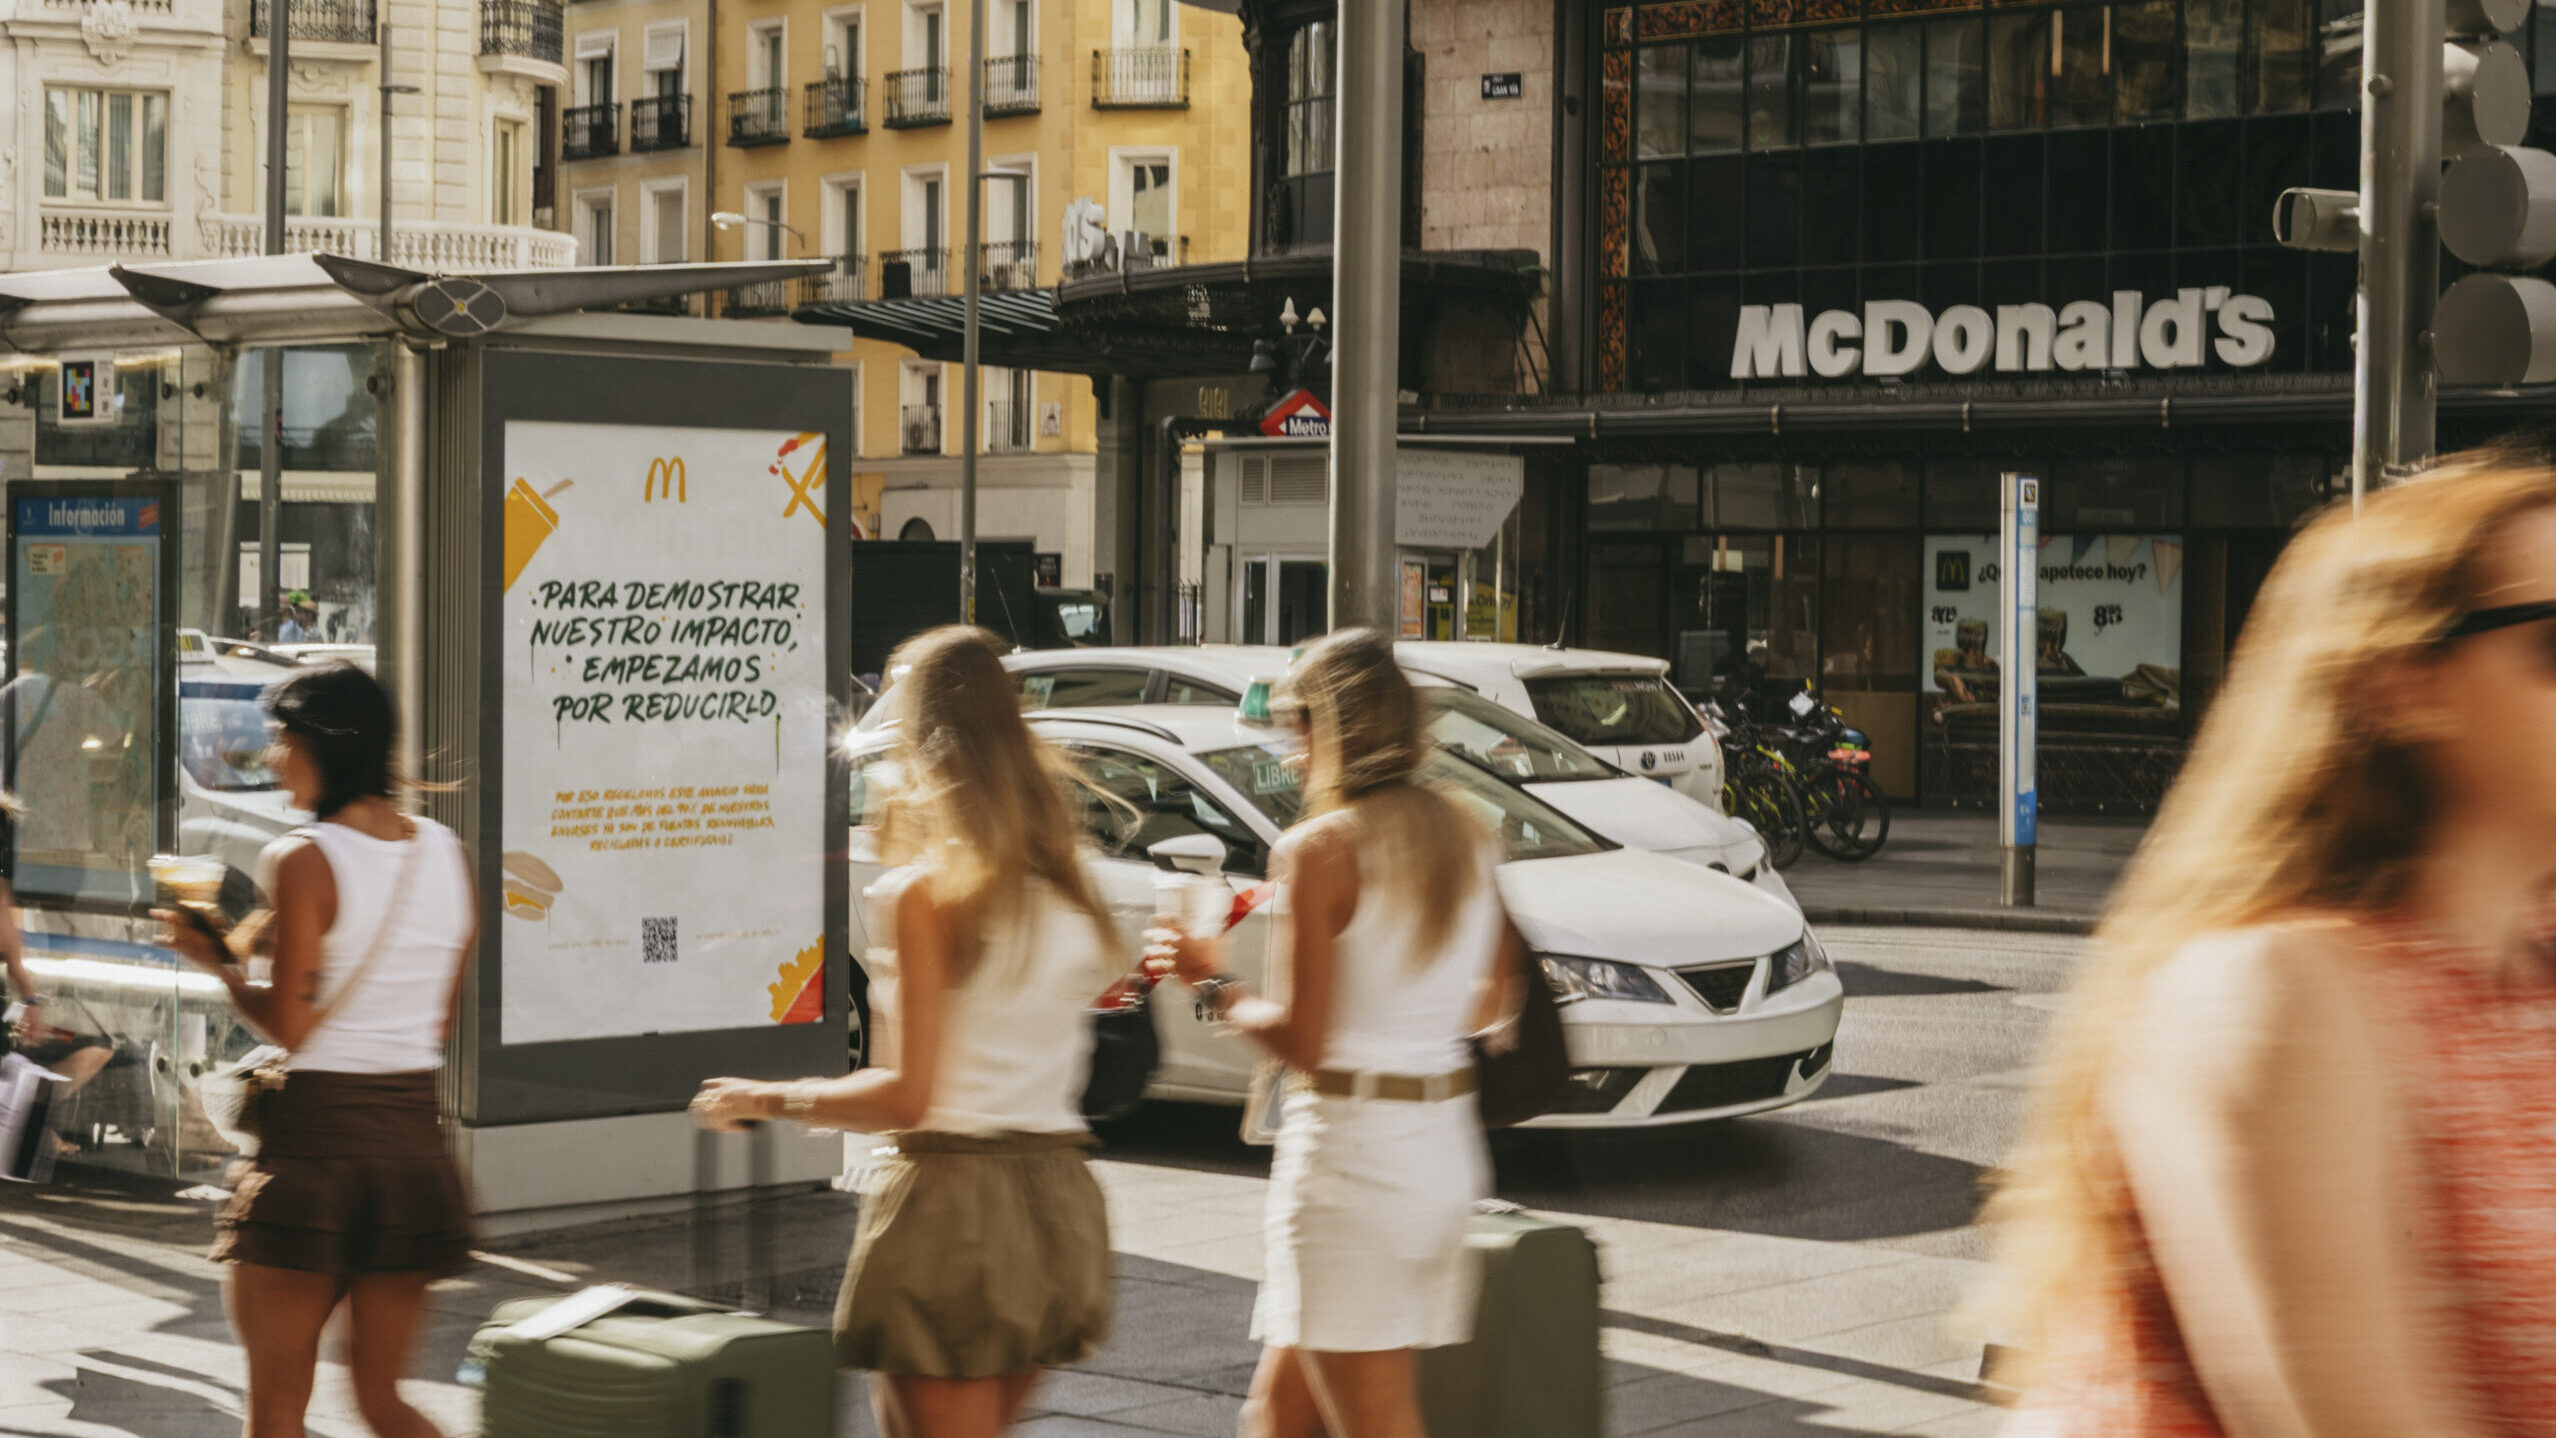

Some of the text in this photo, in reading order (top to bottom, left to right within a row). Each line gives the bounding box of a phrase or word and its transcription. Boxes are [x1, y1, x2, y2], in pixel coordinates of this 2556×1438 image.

[1730, 286, 2275, 379] McDonald's
[1289, 418, 1327, 436] Metro
[49, 500, 125, 527] Información
[2039, 565, 2104, 583] apetece
[2107, 562, 2147, 584] hoy?
[539, 579, 800, 612] PARA DEMOSTRAR
[530, 617, 799, 653] NUESTRO IMPACTO,
[582, 655, 761, 684] EMPEZAMOS
[553, 692, 613, 724] POR
[1256, 764, 1299, 788] LIBRE
